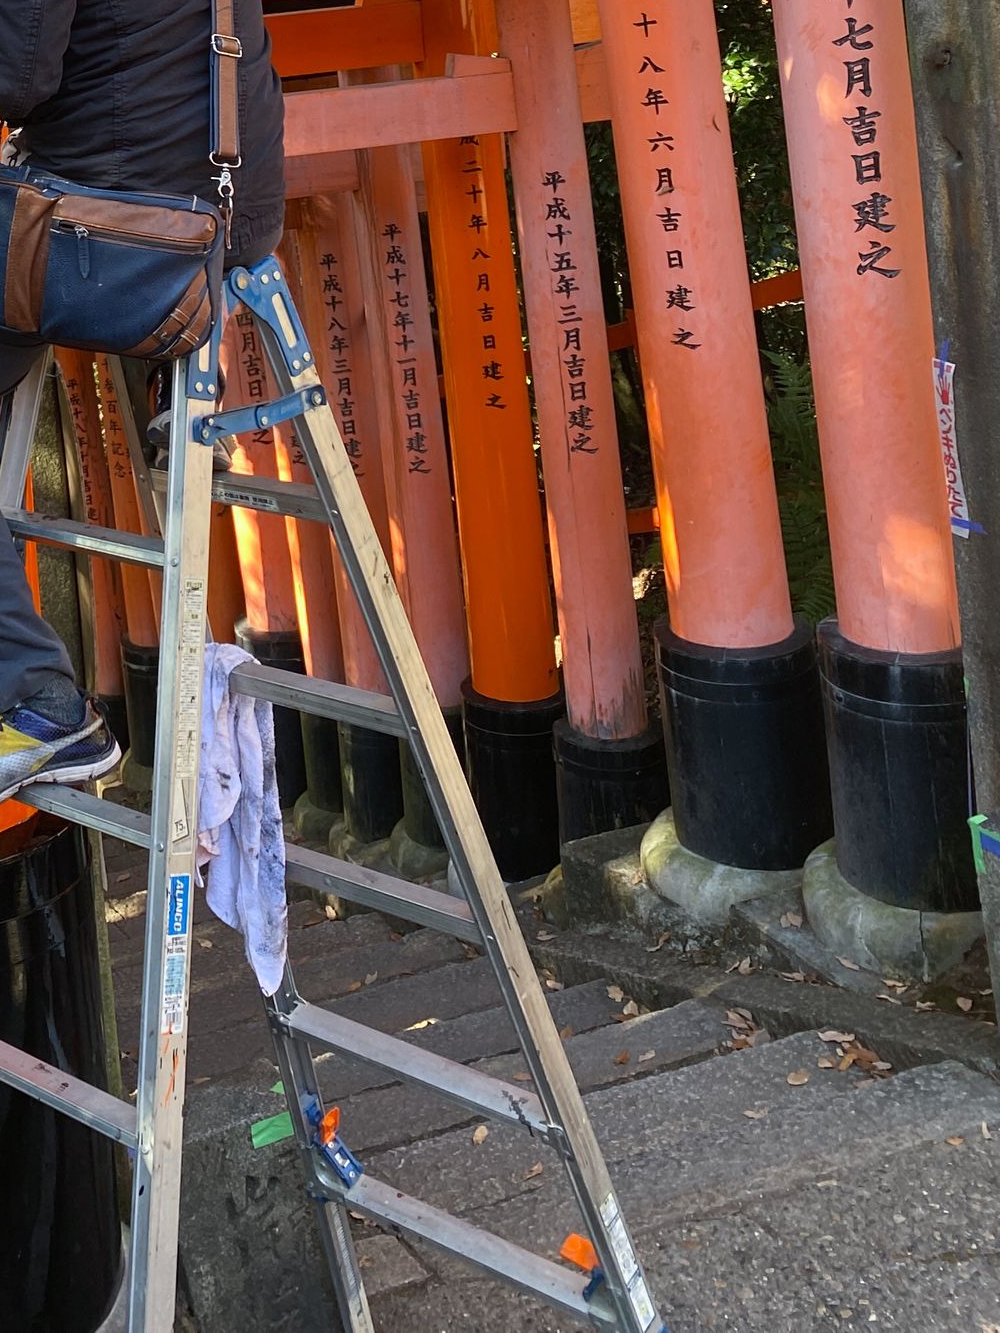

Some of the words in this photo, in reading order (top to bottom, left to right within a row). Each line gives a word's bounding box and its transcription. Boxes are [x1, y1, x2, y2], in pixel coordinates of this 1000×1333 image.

[236, 312, 274, 445] 四月吉日之
[320, 253, 365, 478] 平成十八年三月吉日建之
[382, 223, 431, 474] 平成十七年十一月吉日建之
[541, 171, 599, 454] 平成十五年三月吉日建之
[173, 878, 185, 932] ALINCO
